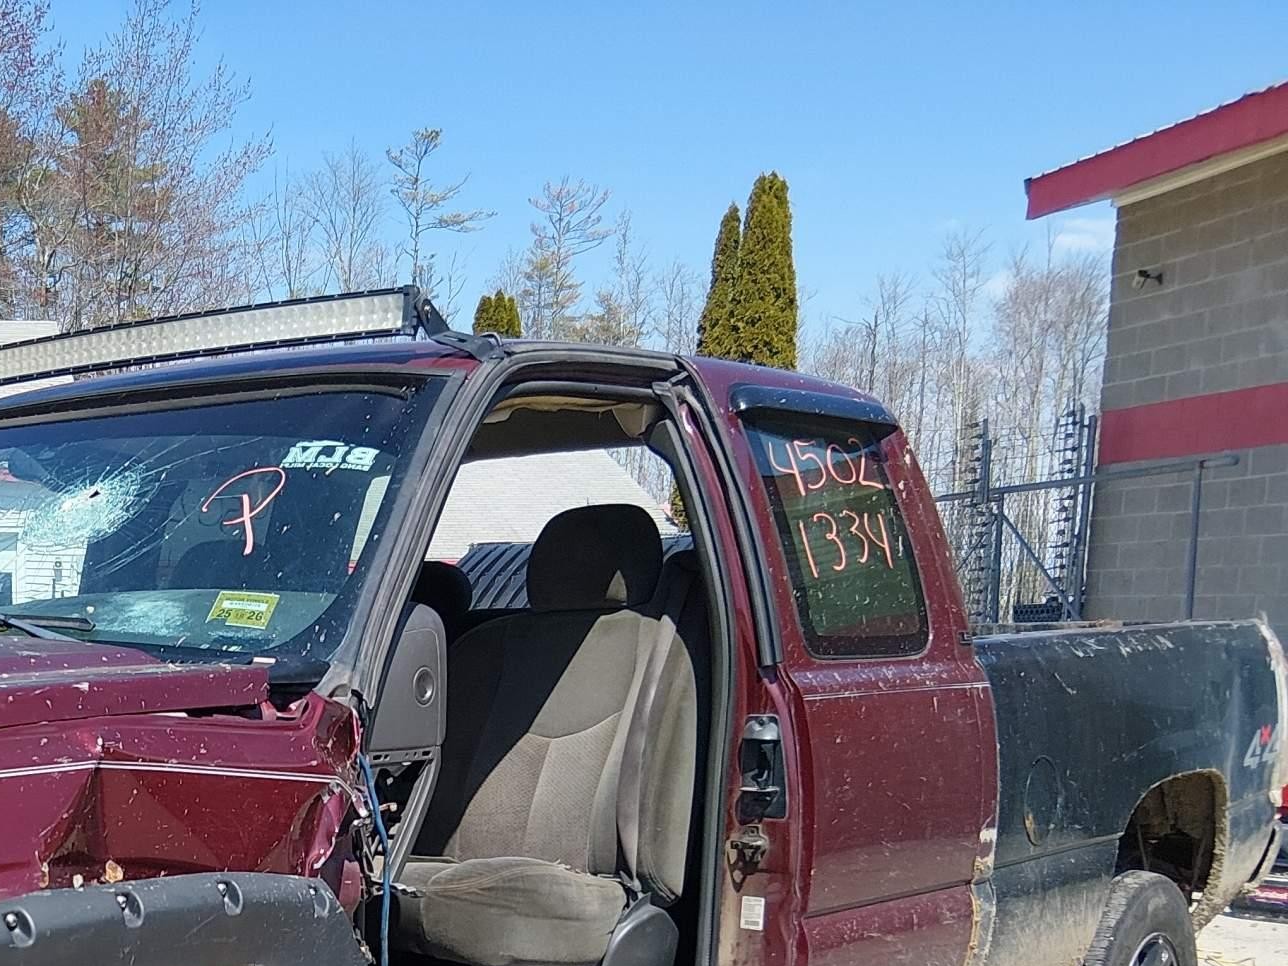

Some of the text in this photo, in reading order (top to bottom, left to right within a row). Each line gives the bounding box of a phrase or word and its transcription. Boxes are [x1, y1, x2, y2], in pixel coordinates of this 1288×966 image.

[768, 437, 885, 496] 4502
[201, 466, 286, 556] P
[798, 509, 894, 578] 1334
[216, 608, 232, 618] 25
[247, 610, 264, 621] 26
